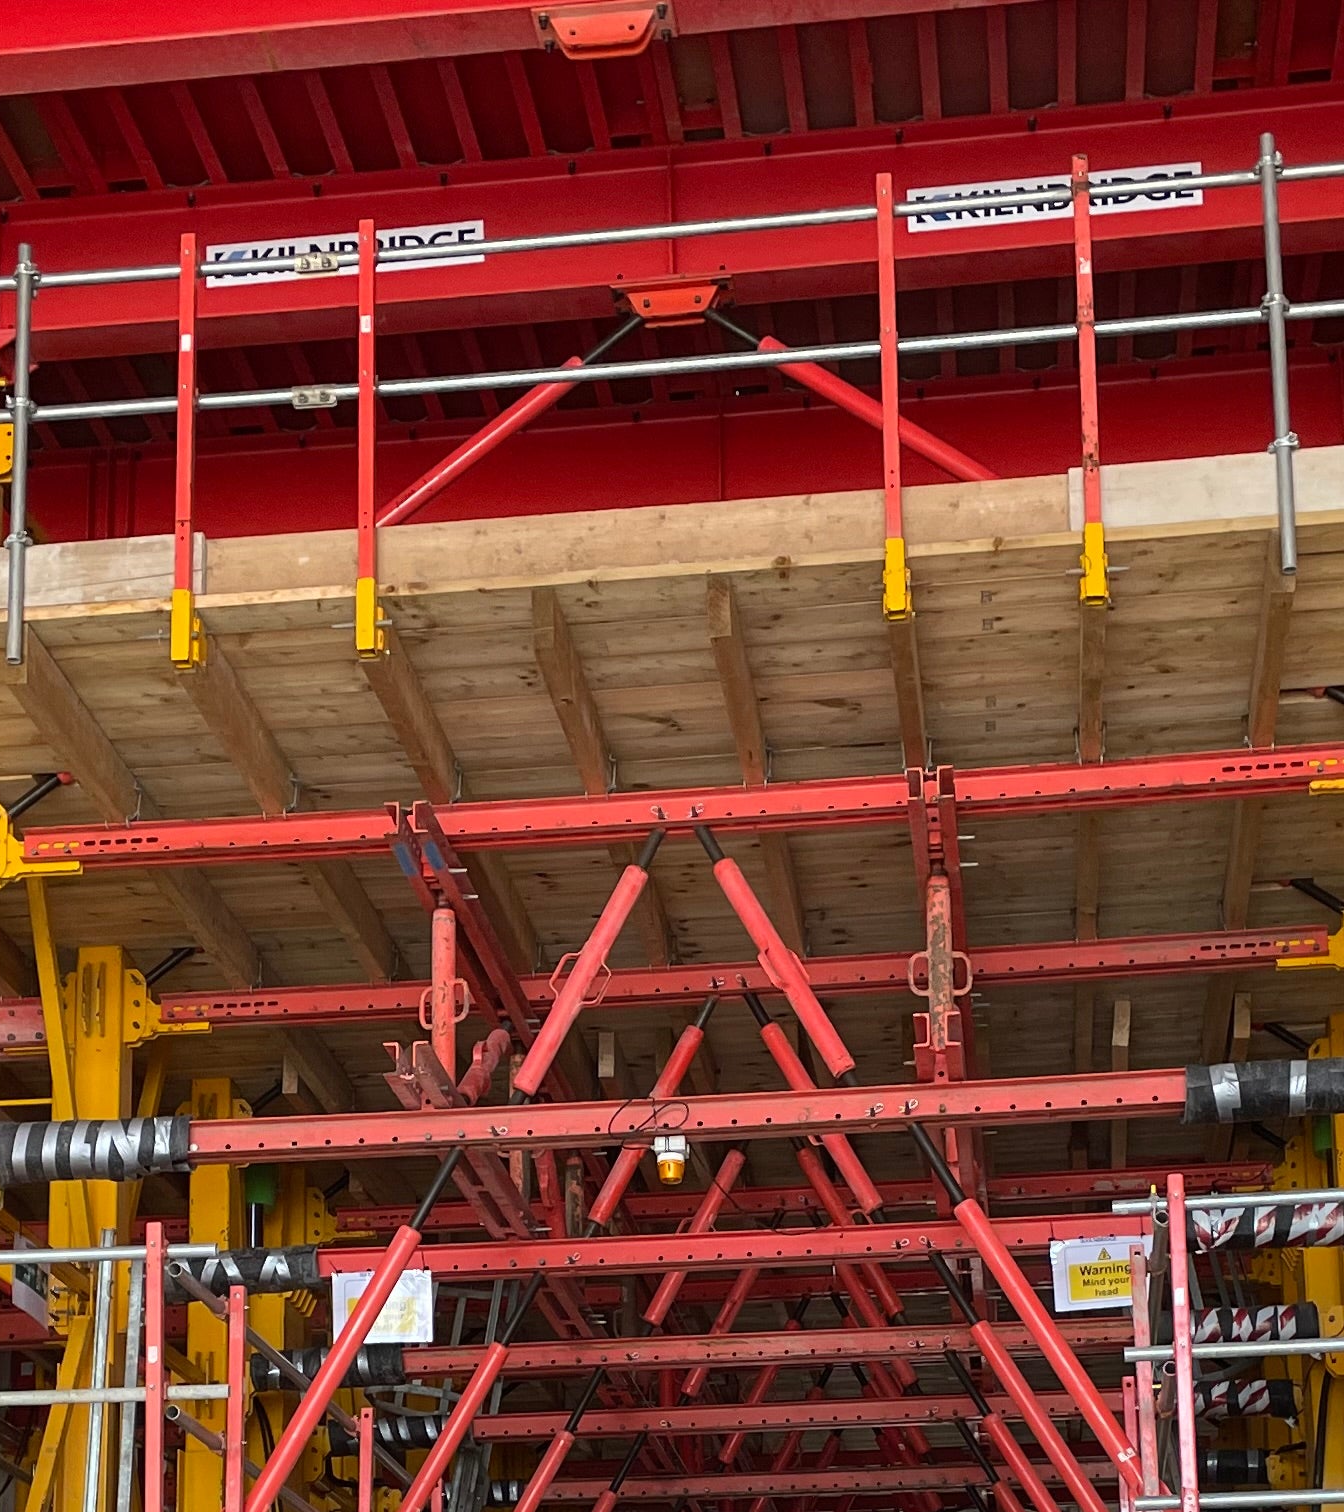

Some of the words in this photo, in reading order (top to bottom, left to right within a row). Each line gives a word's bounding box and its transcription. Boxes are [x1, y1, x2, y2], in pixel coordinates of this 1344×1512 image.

[1080, 1264, 1131, 1276] Warning
[1083, 1278, 1106, 1287] Mind
[1095, 1287, 1119, 1297] head
